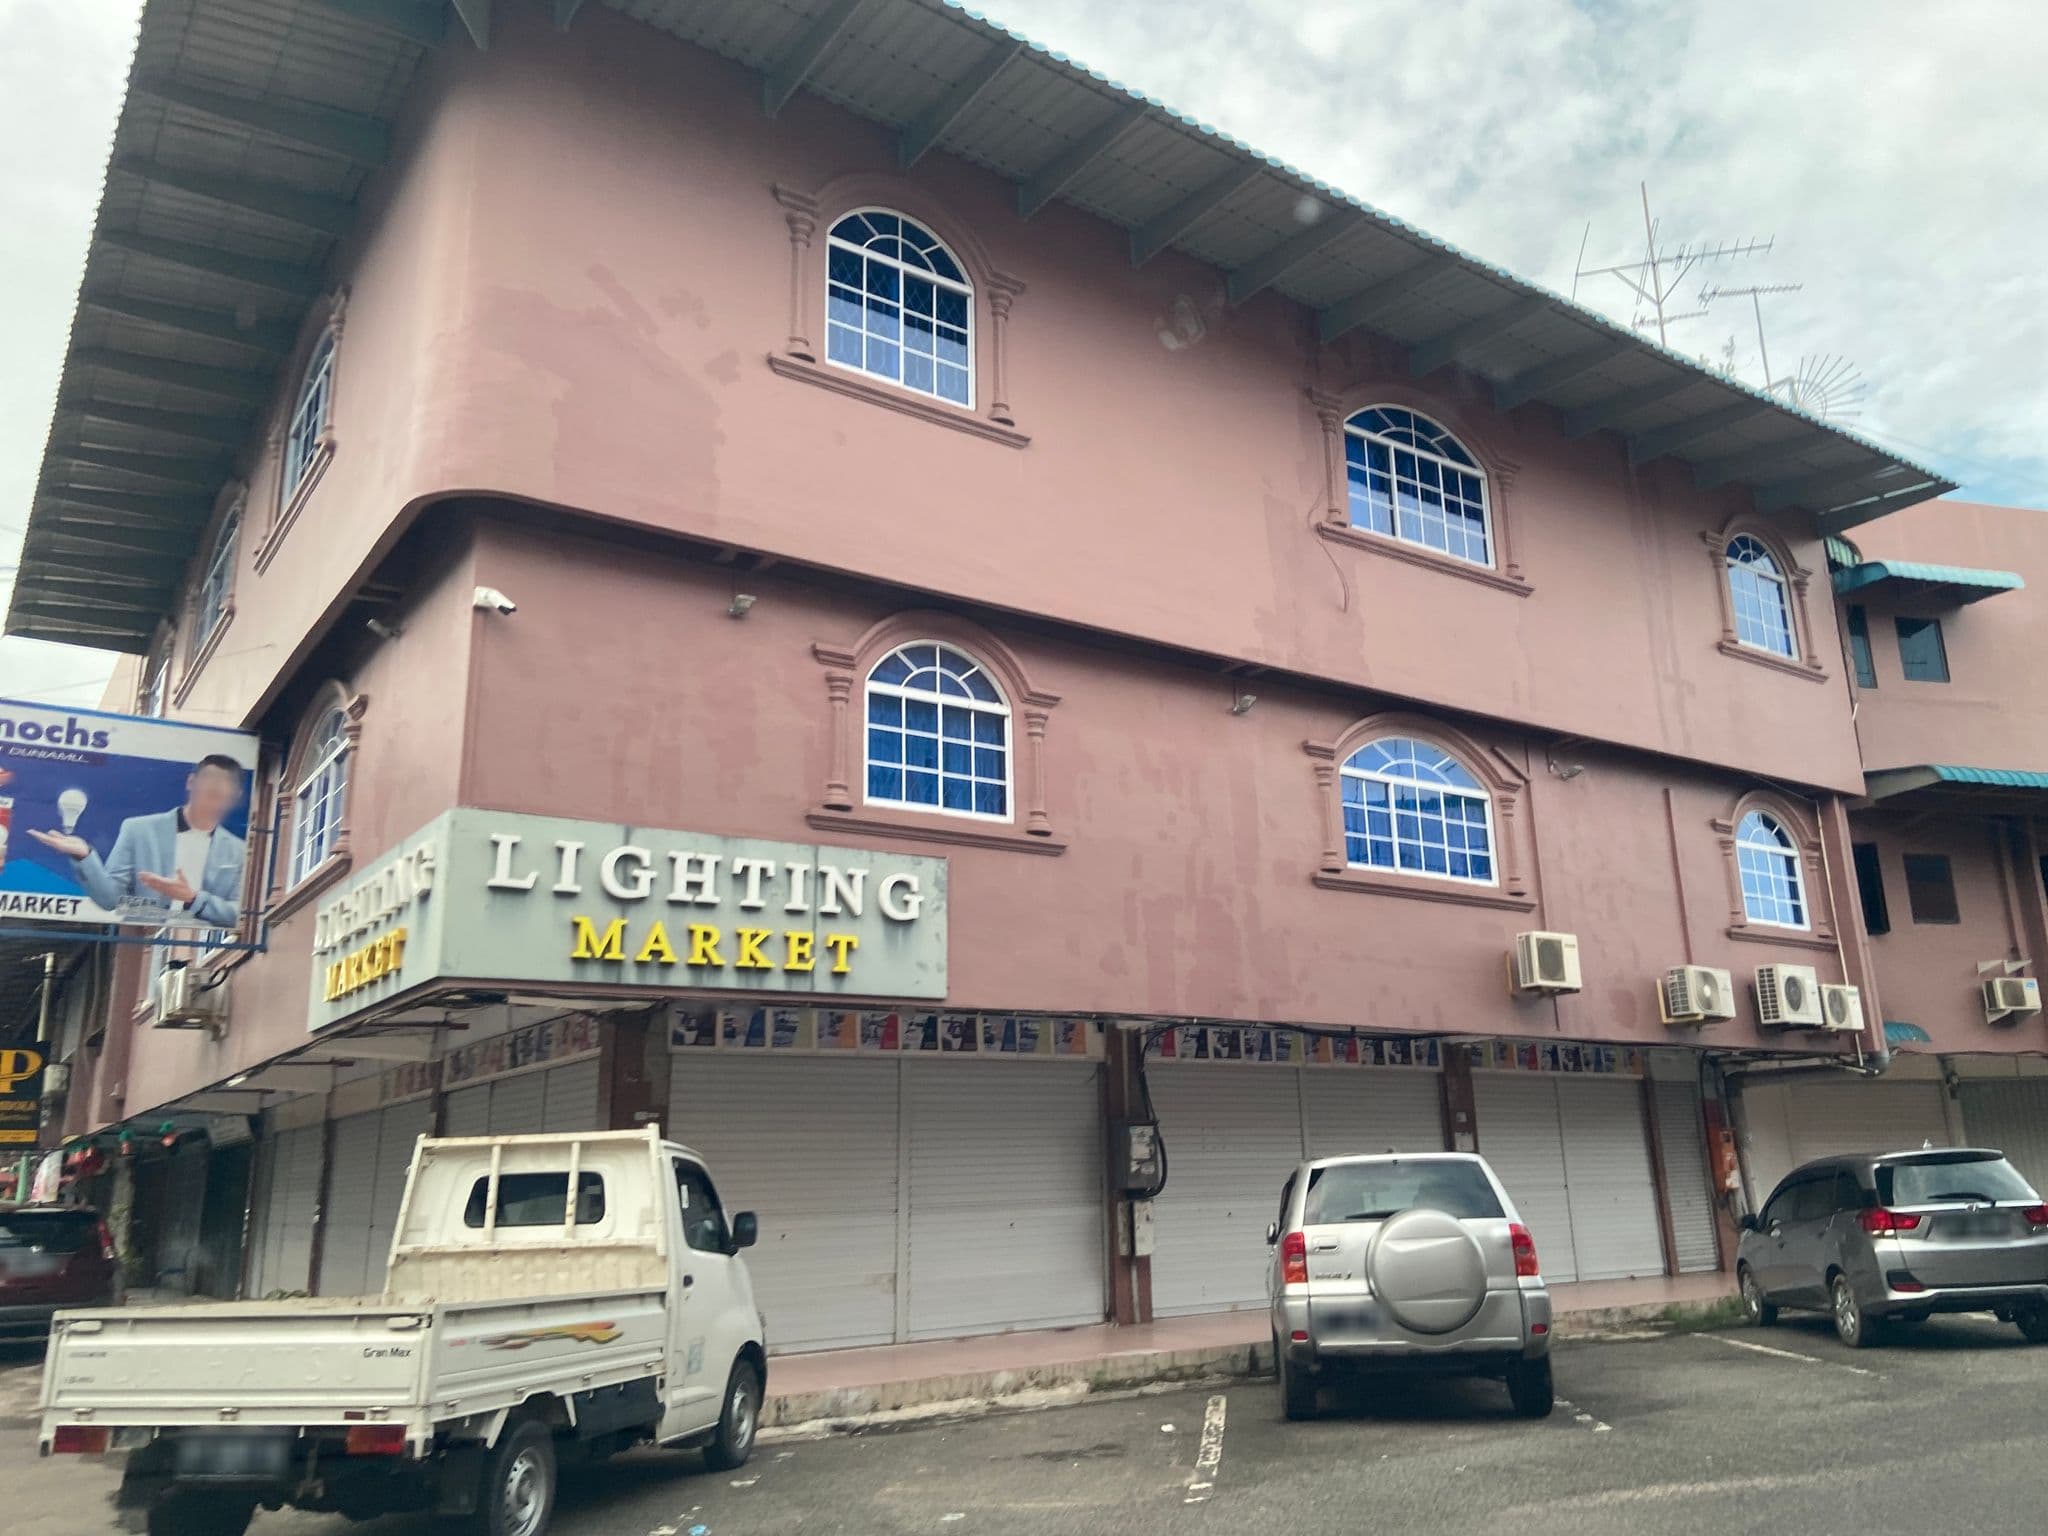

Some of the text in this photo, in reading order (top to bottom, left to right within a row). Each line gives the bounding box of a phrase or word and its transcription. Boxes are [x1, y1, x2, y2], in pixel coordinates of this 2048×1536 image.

[312, 841, 436, 956] LIGHTING
[487, 832, 925, 921] LIGHTING
[323, 926, 408, 1002] MARKET
[571, 915, 860, 973] MARKET
